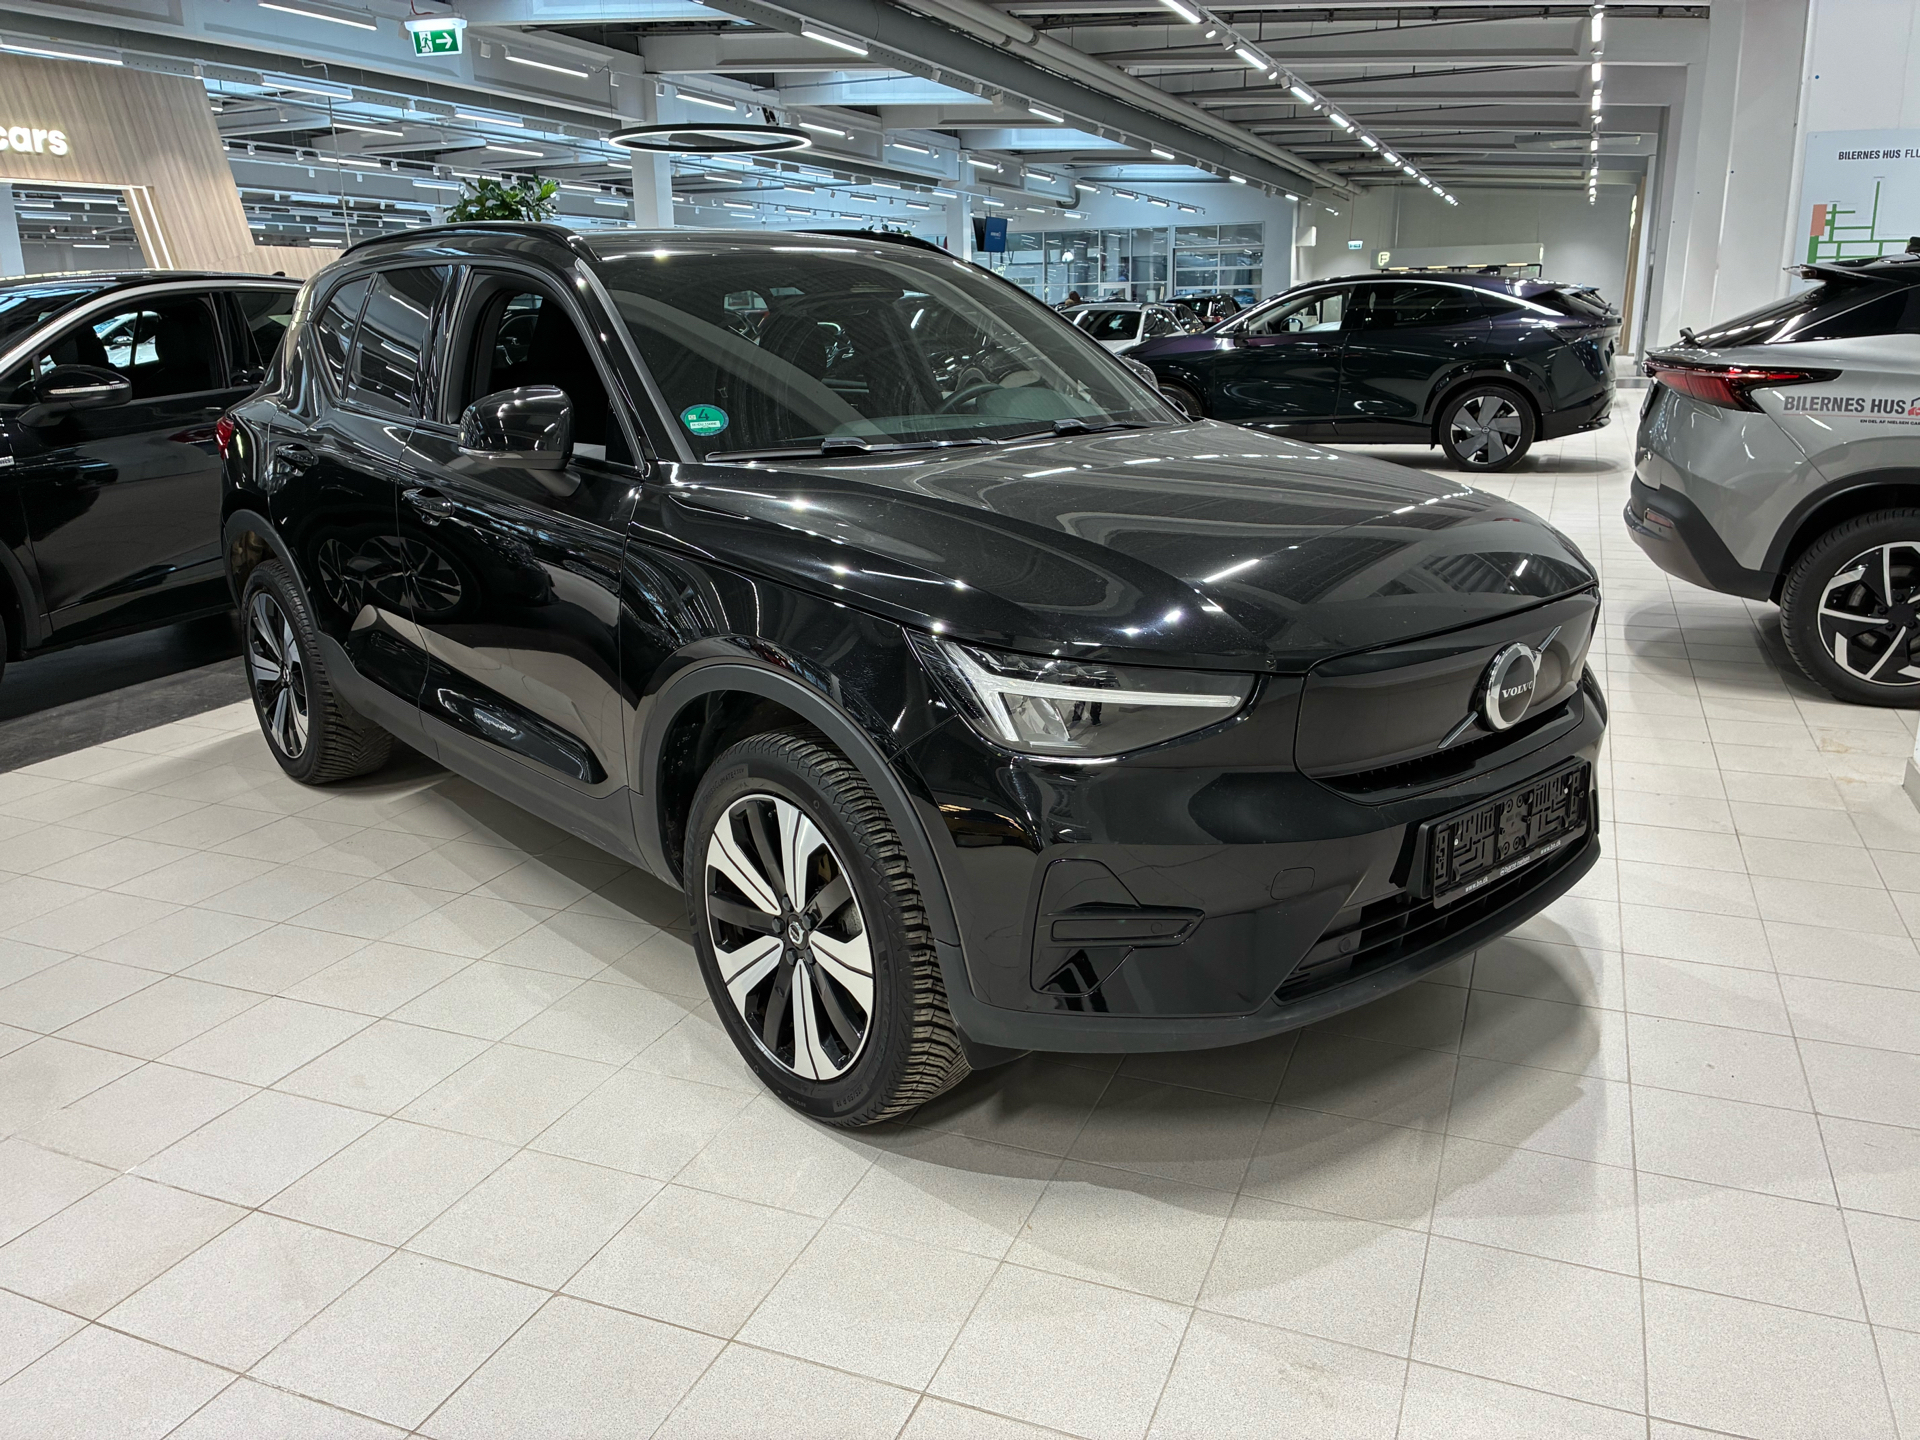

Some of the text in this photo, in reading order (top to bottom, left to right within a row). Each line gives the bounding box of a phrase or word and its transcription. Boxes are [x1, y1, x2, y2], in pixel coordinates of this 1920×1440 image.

[1838, 150, 1881, 160] BILERNES
[1882, 149, 1901, 159] HUS
[1783, 396, 1906, 415] BILERNES HUS
[698, 409, 710, 420] 4
